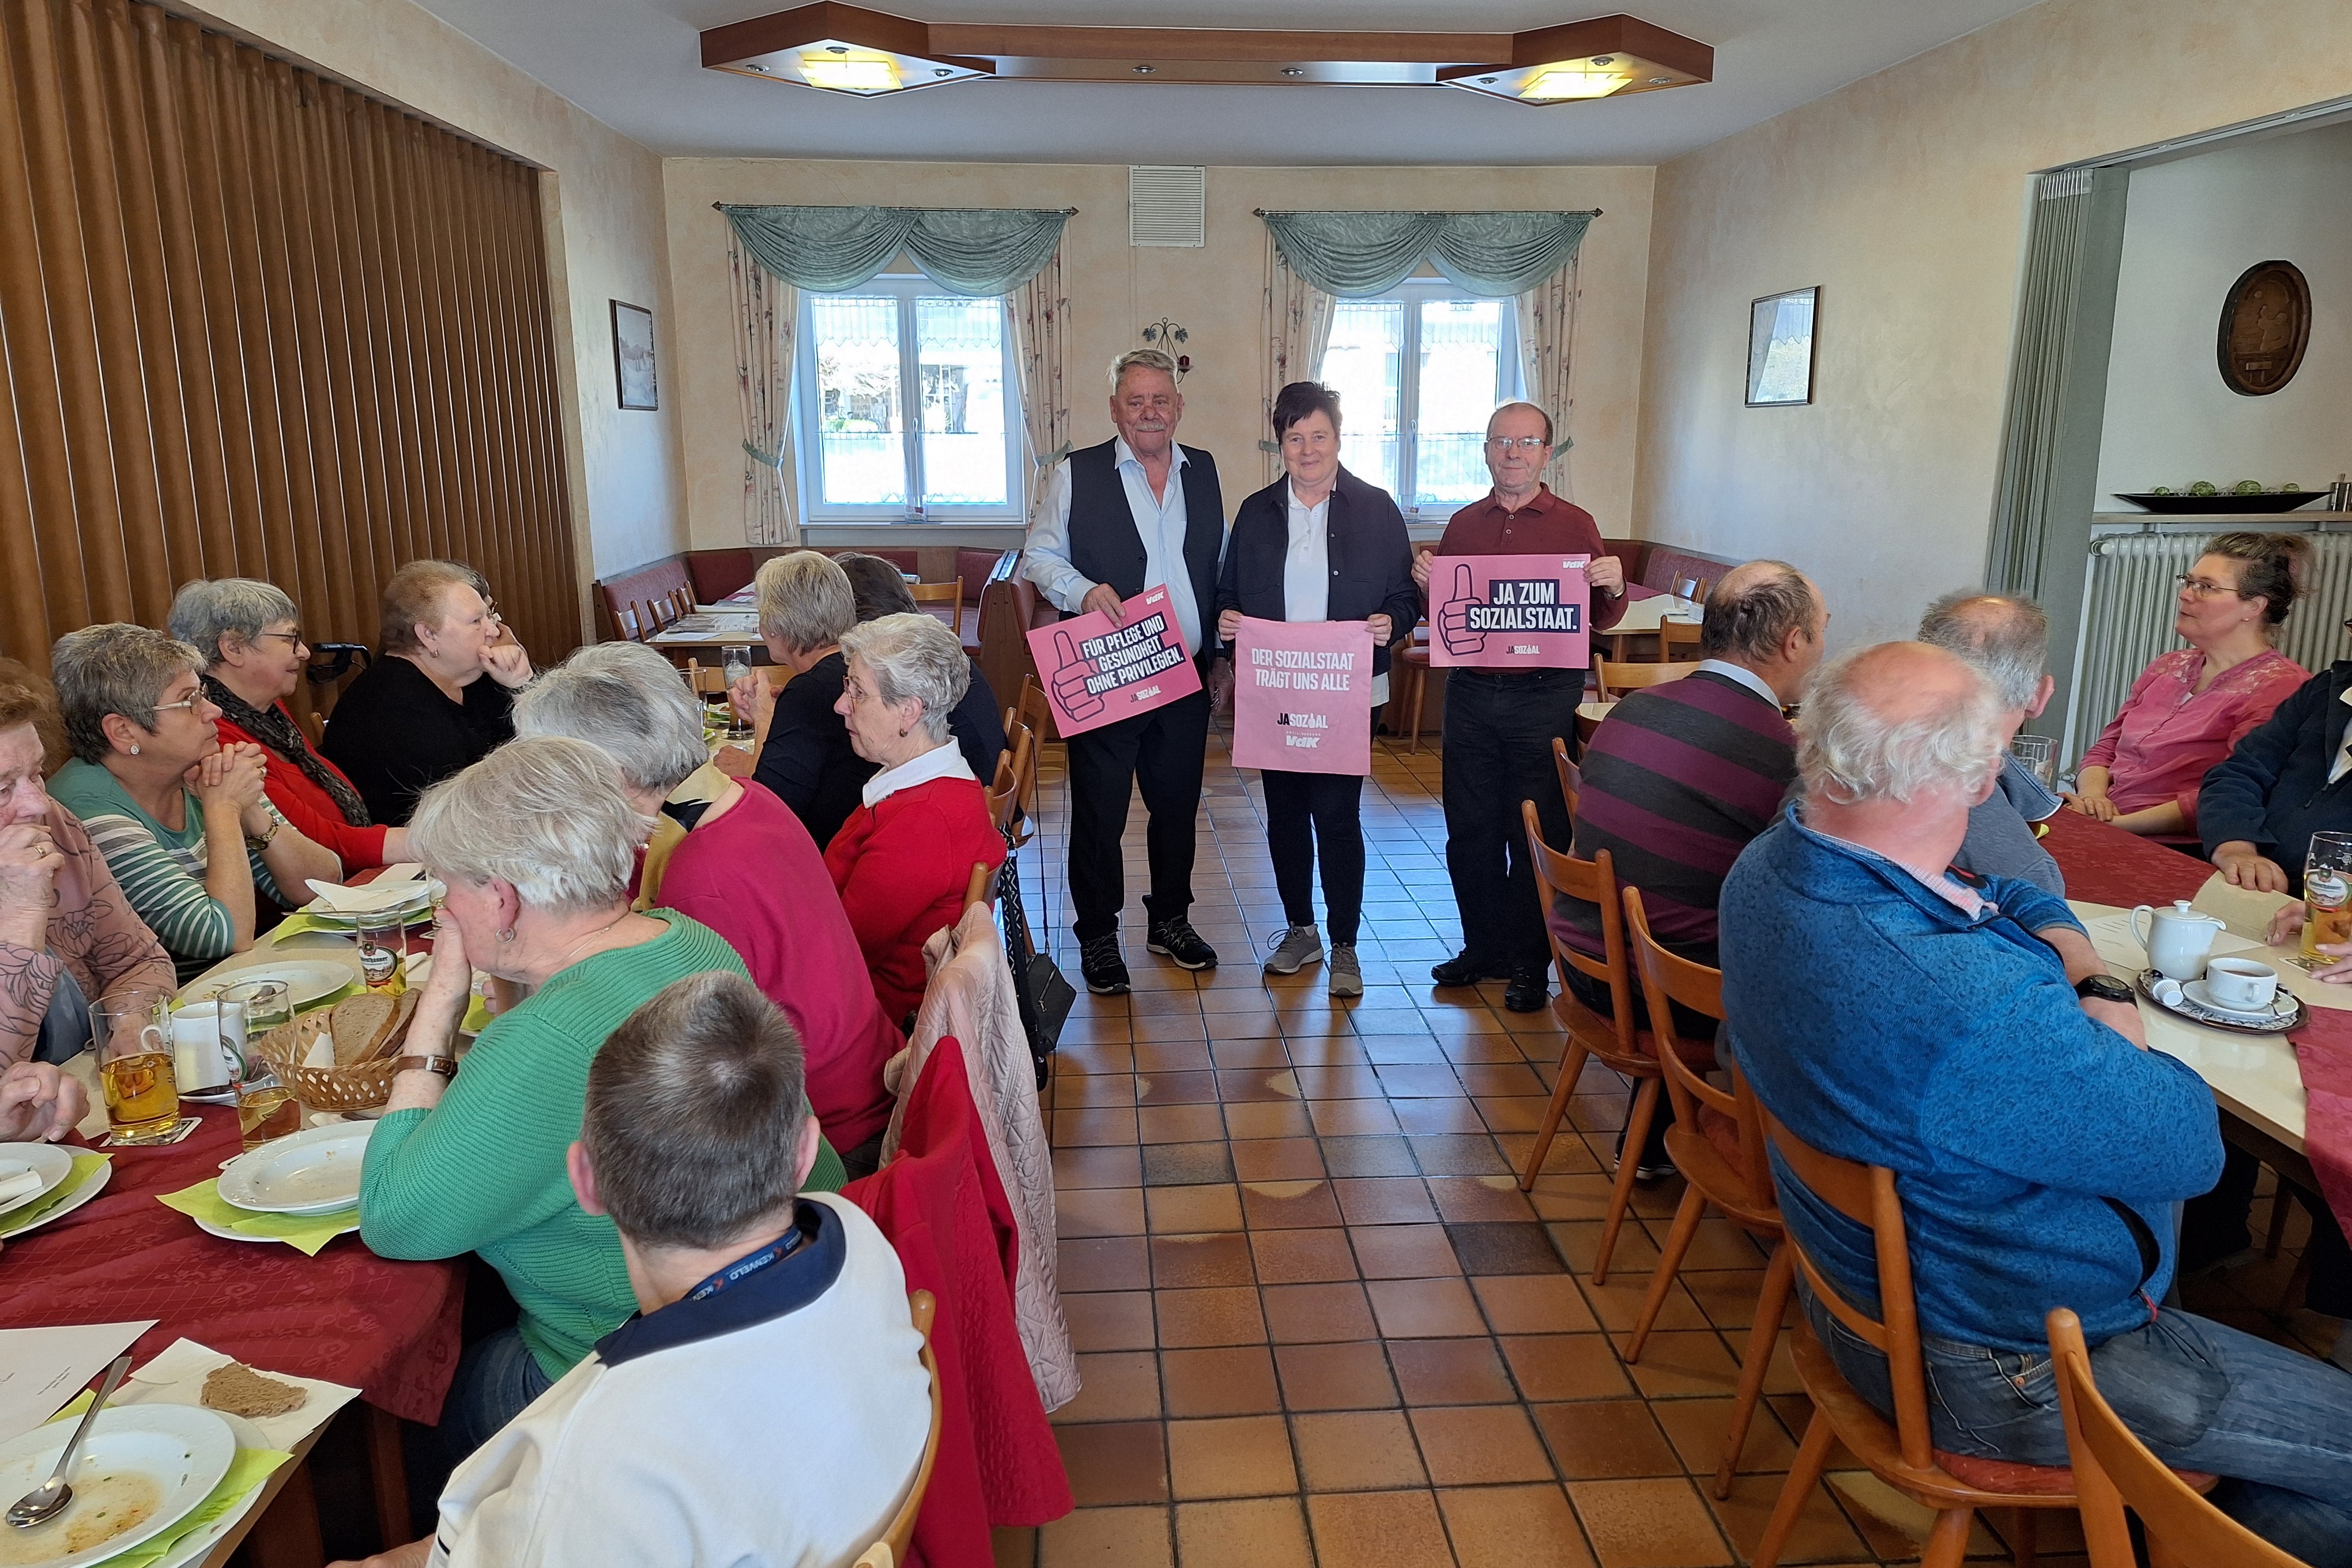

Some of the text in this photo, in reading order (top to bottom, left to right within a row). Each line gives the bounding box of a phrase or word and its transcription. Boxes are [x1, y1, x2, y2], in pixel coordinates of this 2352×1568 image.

[1145, 591, 1164, 605] VdK
[1493, 582, 1555, 605] JA ZUM
[1470, 608, 1577, 630] SOZIALSTAAT.
[1081, 615, 1165, 659] FÜR PFLEGE UND
[1098, 635, 1162, 672] GESUNDHEIT
[1252, 647, 1355, 671] DER SOZIALSTAAT
[1086, 646, 1185, 695] OHNE PRIVILEGIEN.
[1255, 668, 1350, 691] TRÄGT UNS ALLE
[1286, 735, 1321, 748] VdK
